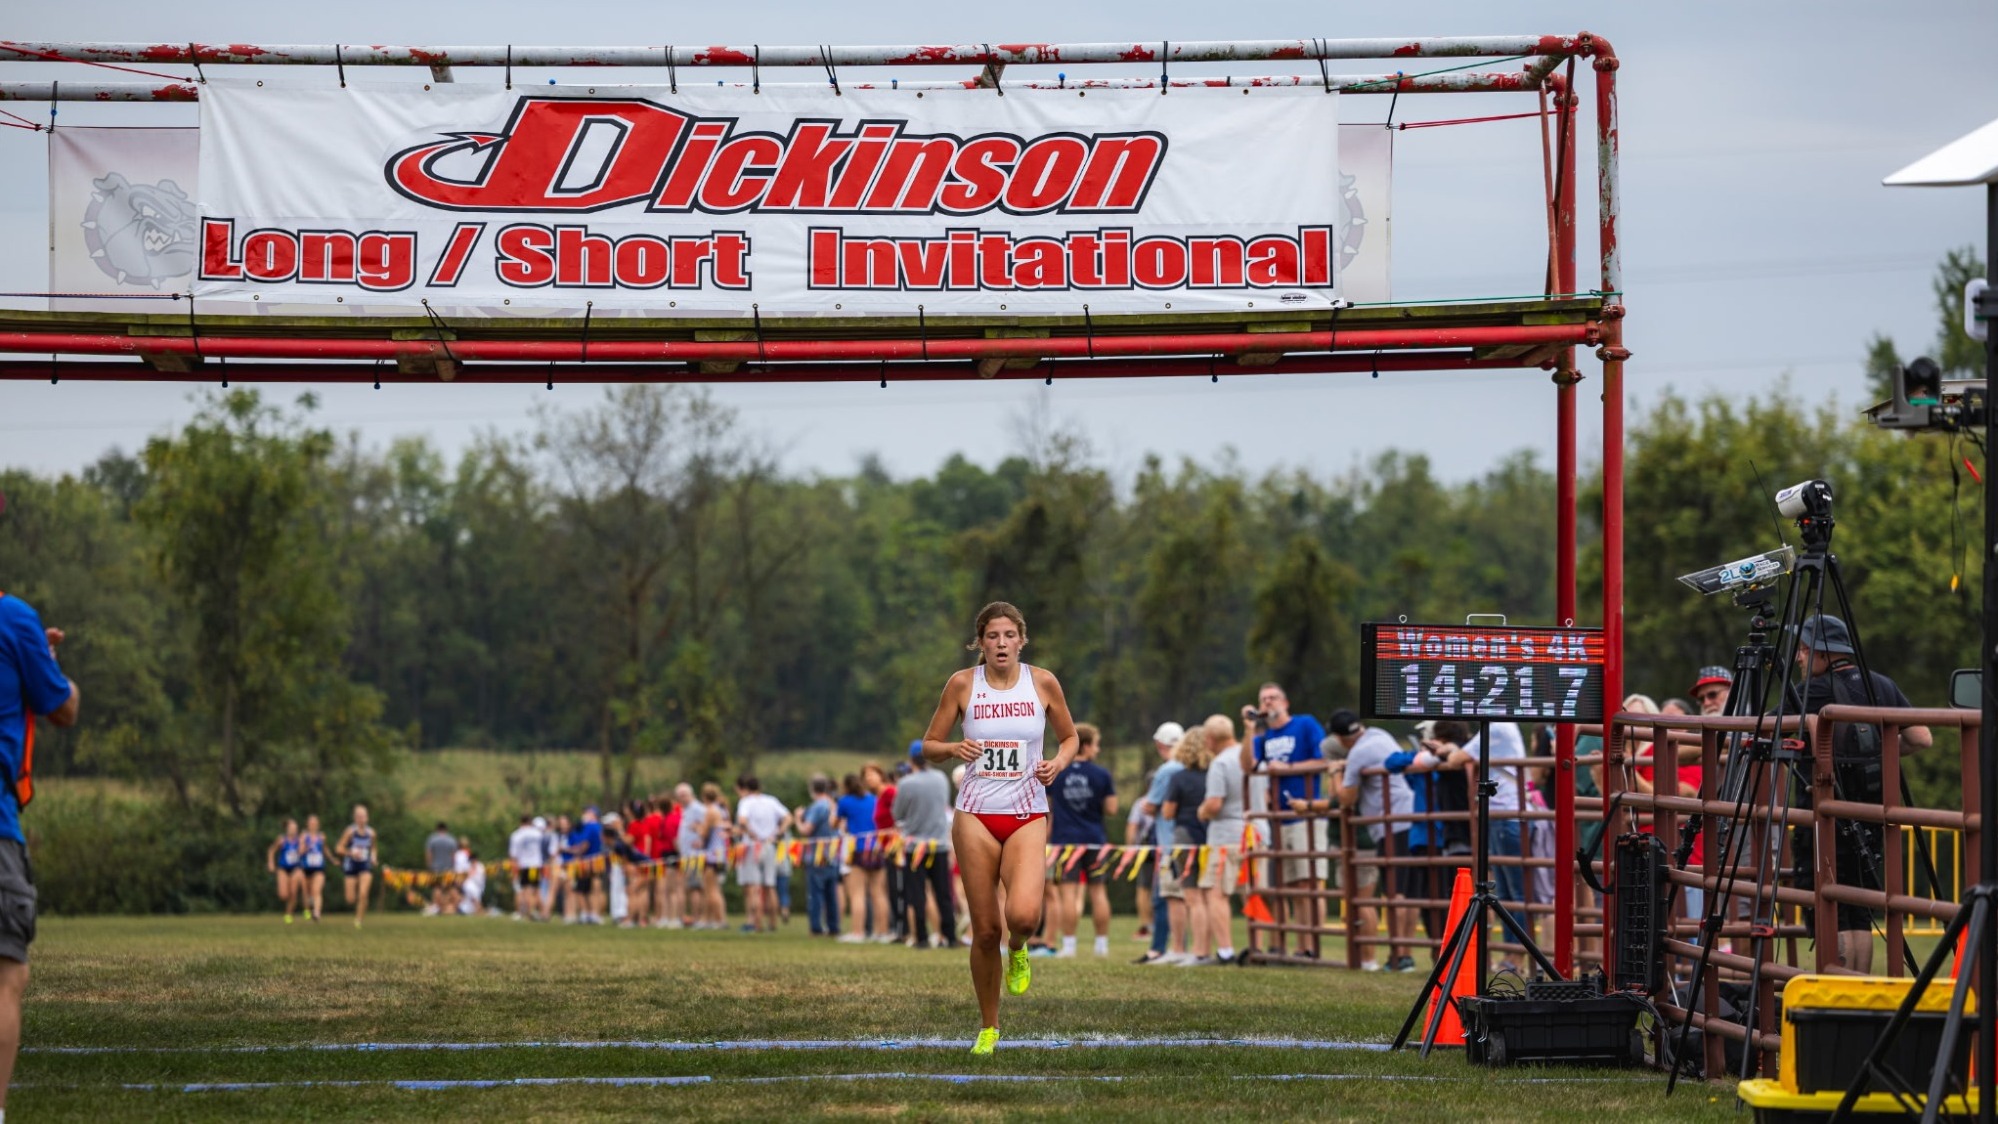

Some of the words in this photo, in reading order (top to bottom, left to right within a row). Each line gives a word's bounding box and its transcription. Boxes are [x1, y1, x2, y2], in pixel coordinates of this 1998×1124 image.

[384, 95, 1168, 214] Dickinson
[198, 216, 417, 291] Long
[427, 222, 486, 288] /
[496, 223, 752, 290] Short
[807, 224, 1334, 291] Invitational
[1397, 628, 1536, 660] Women's
[1547, 633, 1588, 661] 4K
[1399, 663, 1588, 717] 14:21.7
[974, 702, 1035, 720] DICKINSON
[984, 740, 1019, 749] DICKINSON
[984, 748, 1019, 771] 314
